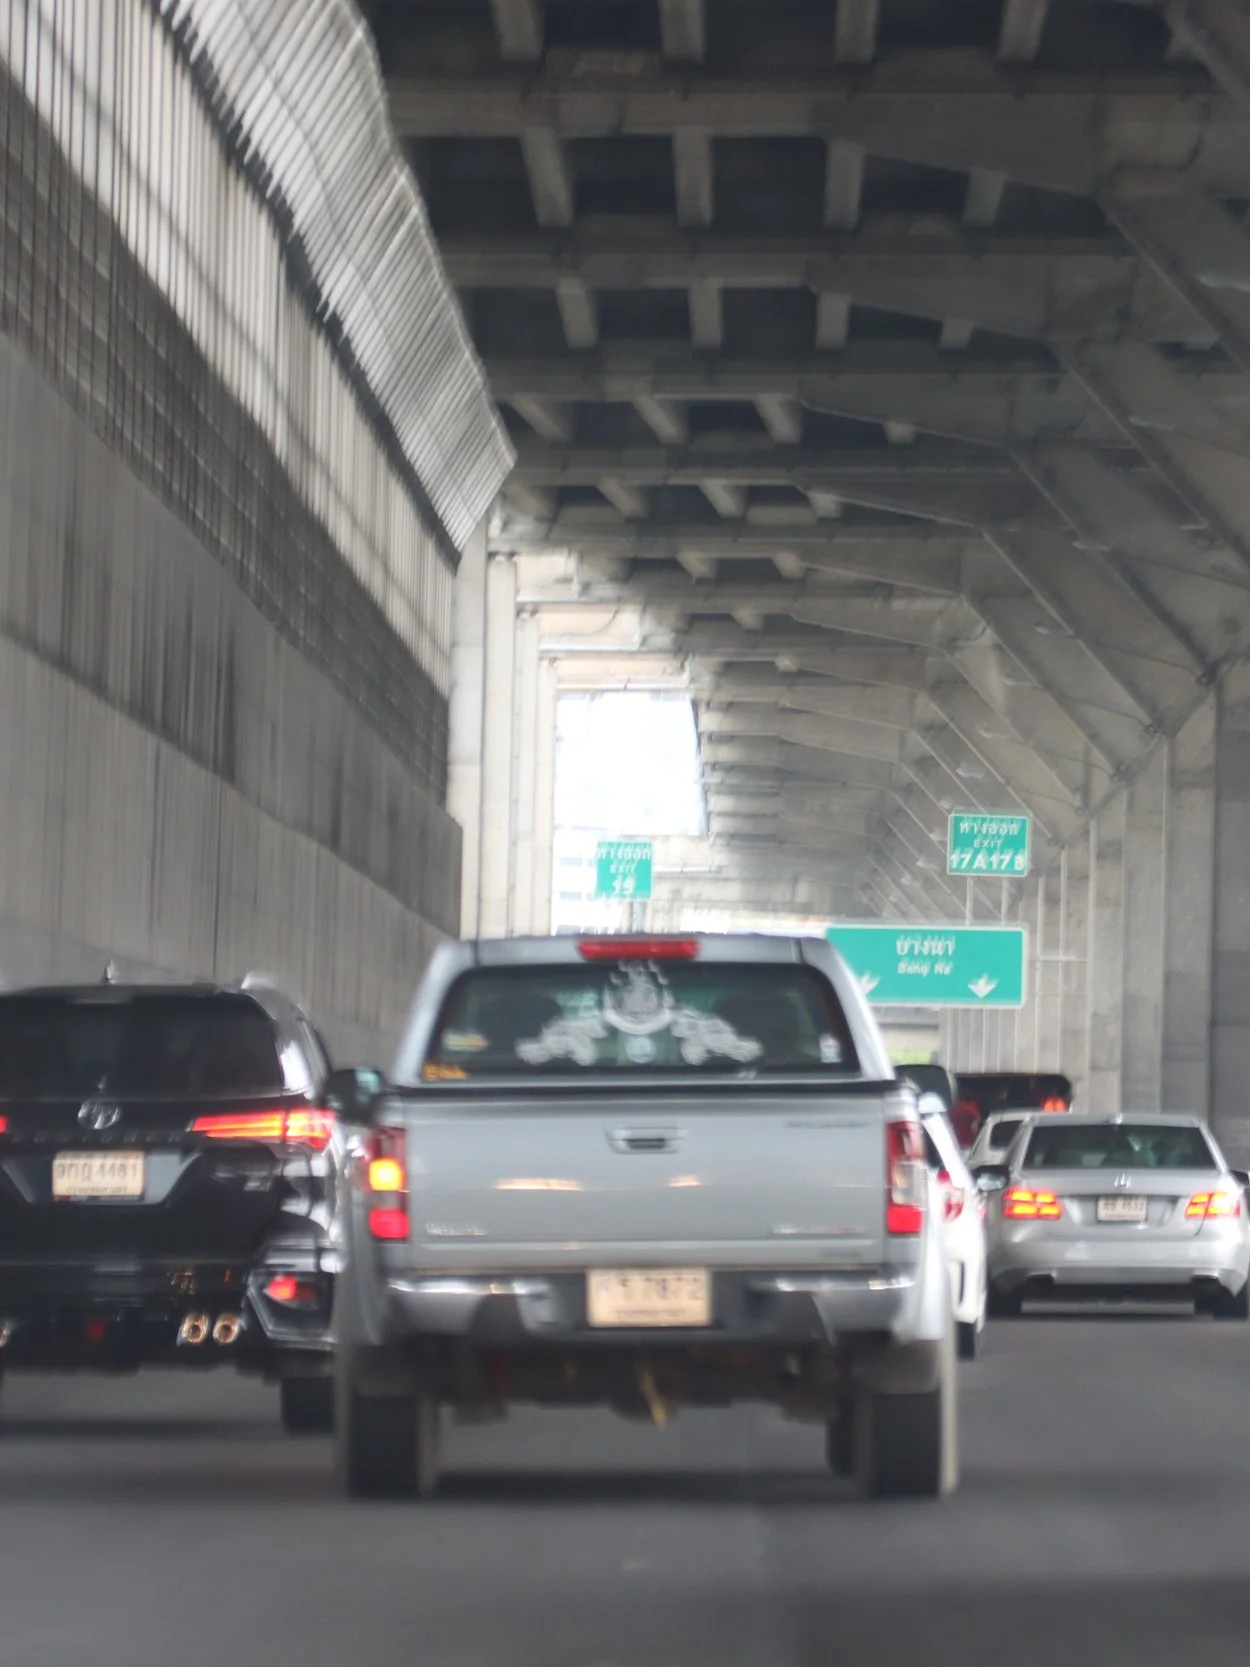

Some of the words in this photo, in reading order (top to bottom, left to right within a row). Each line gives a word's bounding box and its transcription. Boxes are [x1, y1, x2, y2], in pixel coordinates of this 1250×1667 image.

[973, 838, 1003, 848] EXIT
[896, 937, 956, 956] บางนา
[897, 959, 931, 976] Bang
[934, 961, 952, 975] Na
